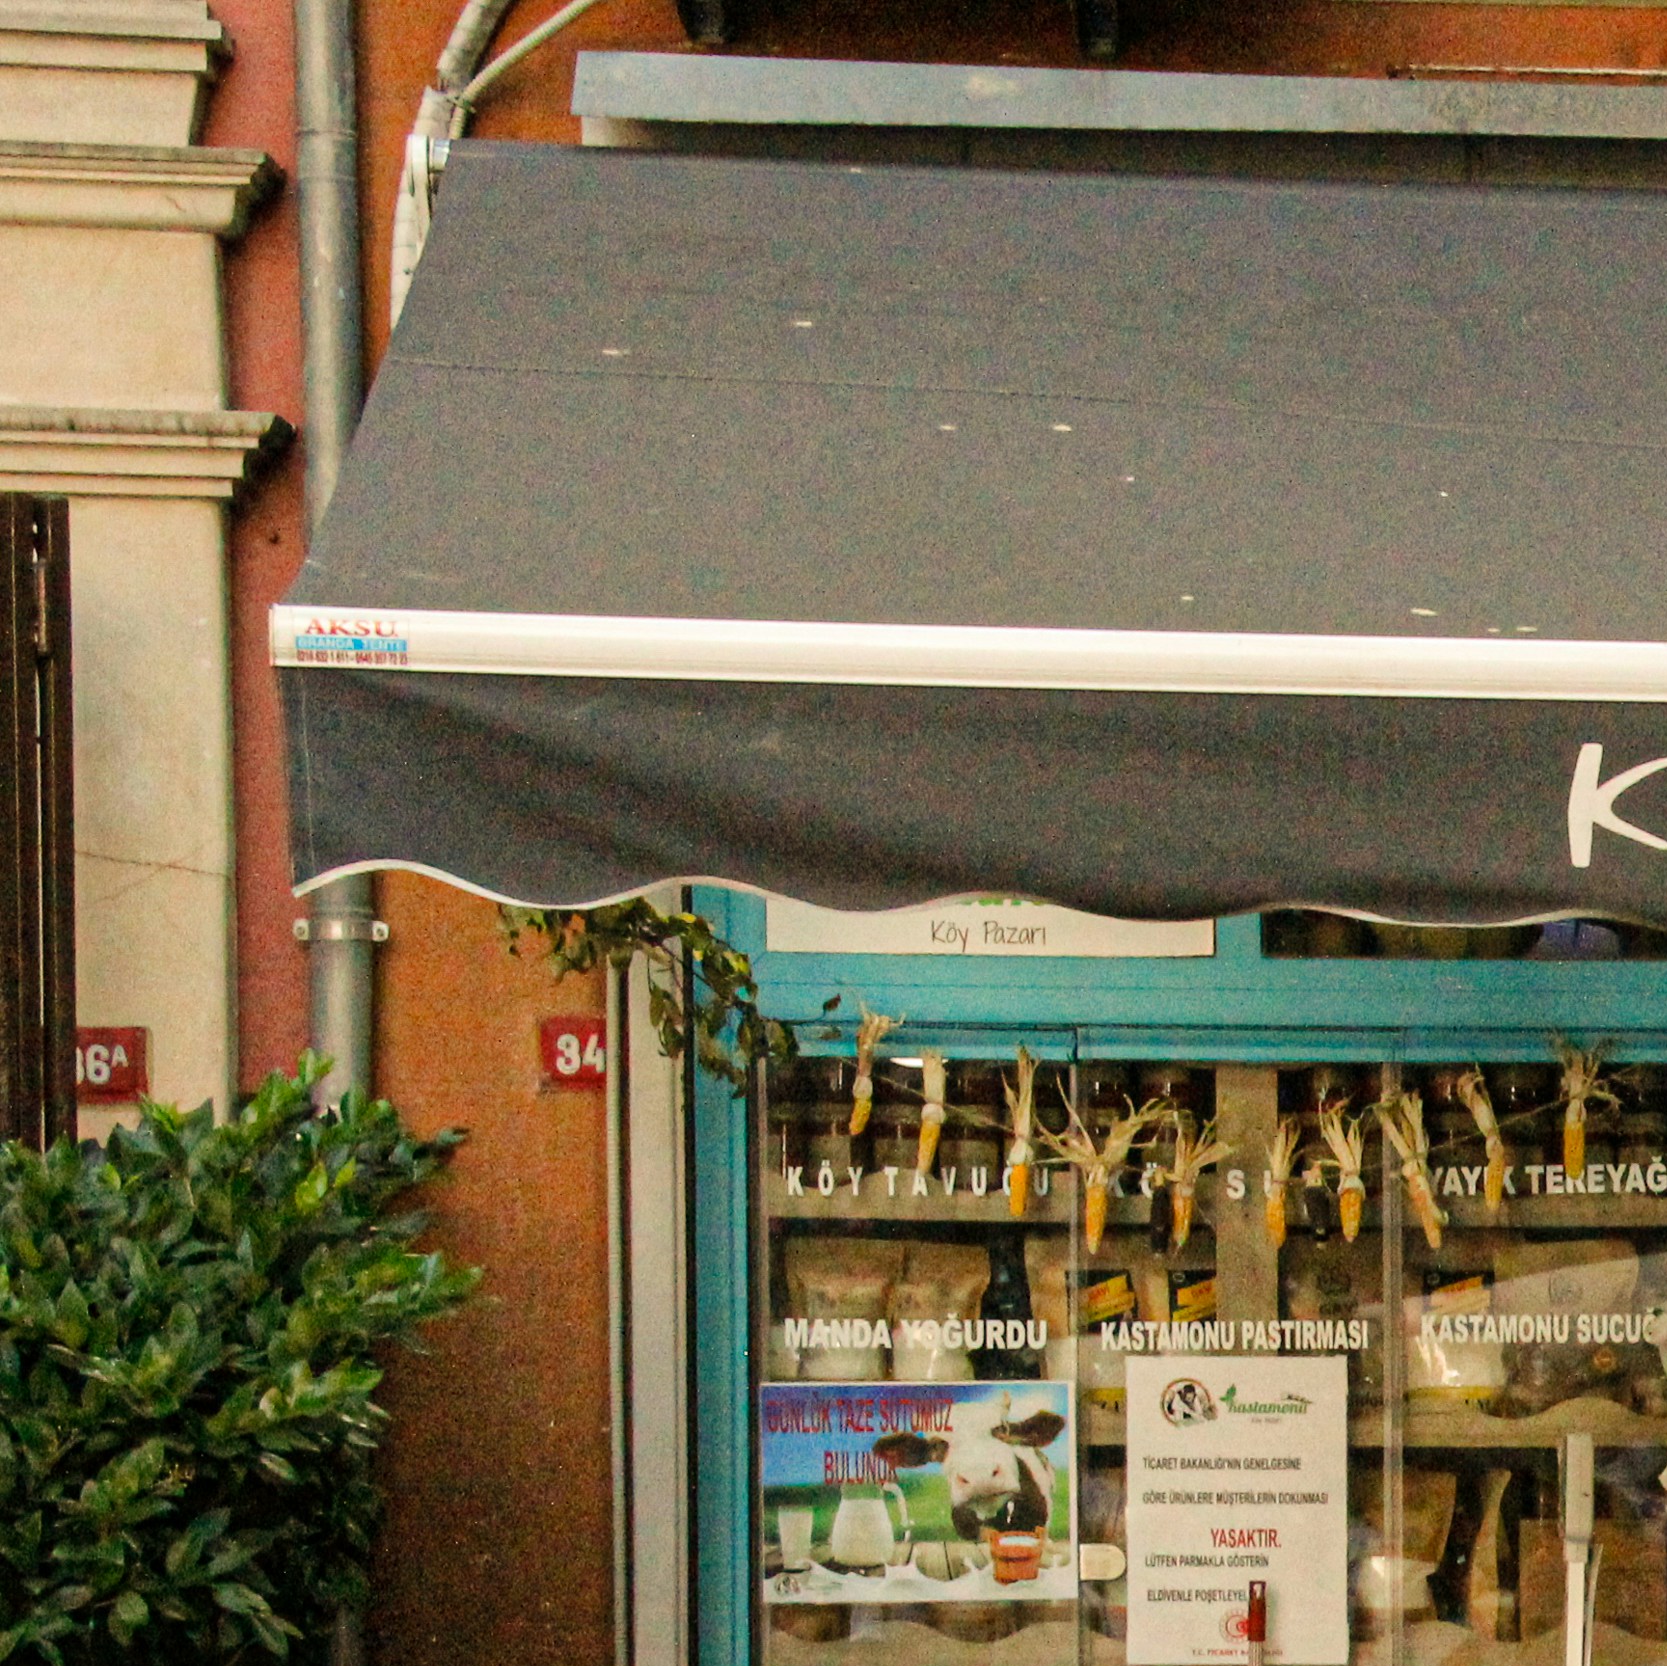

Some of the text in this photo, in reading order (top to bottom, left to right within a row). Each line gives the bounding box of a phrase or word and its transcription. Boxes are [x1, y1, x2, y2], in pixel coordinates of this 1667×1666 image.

[931, 920, 1046, 952] Köy Pazarı
[787, 1160, 863, 1197] KÖY
[784, 1312, 1048, 1350] MANDA YOĞURDU
[1100, 1319, 1370, 1351] KASTAMONU PASTIRMASI
[1420, 1314, 1570, 1344] KASTAMONU
[836, 1398, 875, 1432] TAZE
